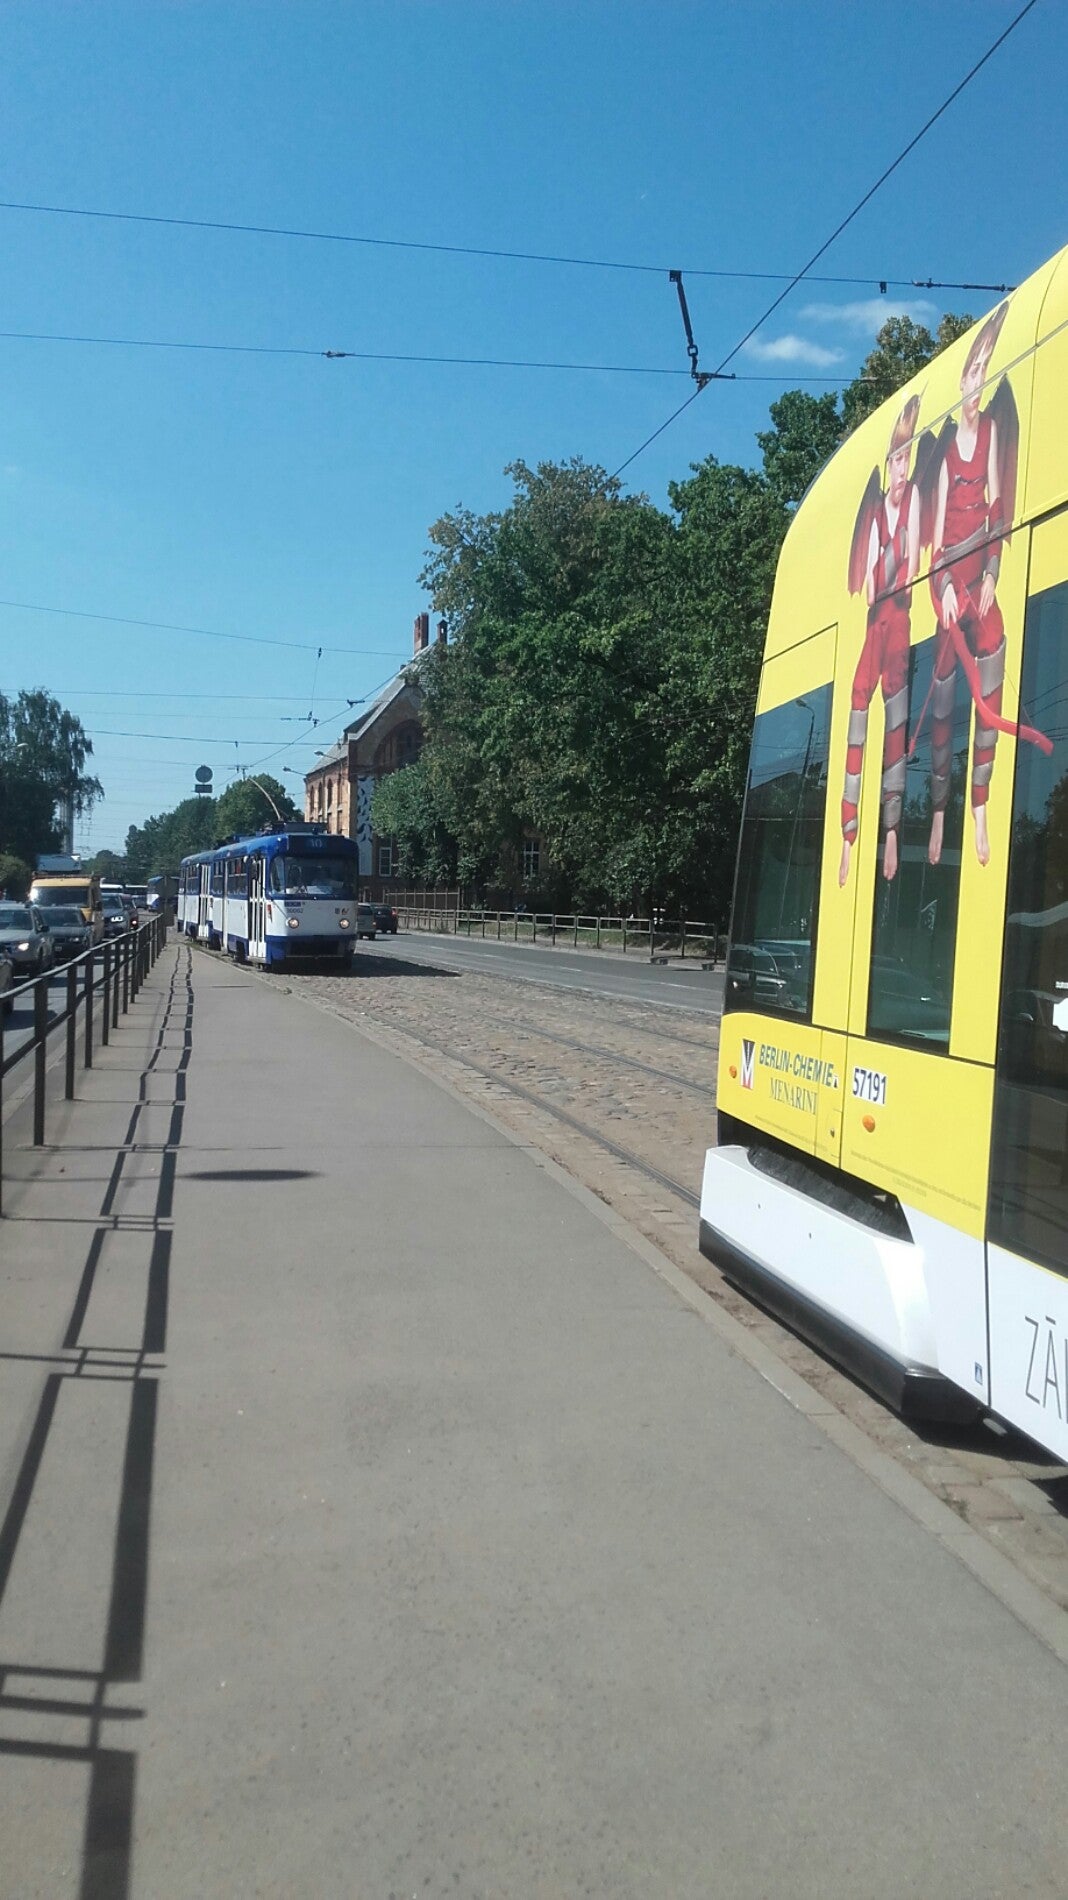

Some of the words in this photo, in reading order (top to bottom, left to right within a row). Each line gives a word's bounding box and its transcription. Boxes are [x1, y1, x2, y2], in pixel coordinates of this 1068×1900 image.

[758, 1044, 834, 1087] BERLIN-CHEMIE
[769, 1077, 818, 1116] MENARINI
[852, 1067, 887, 1105] 57191
